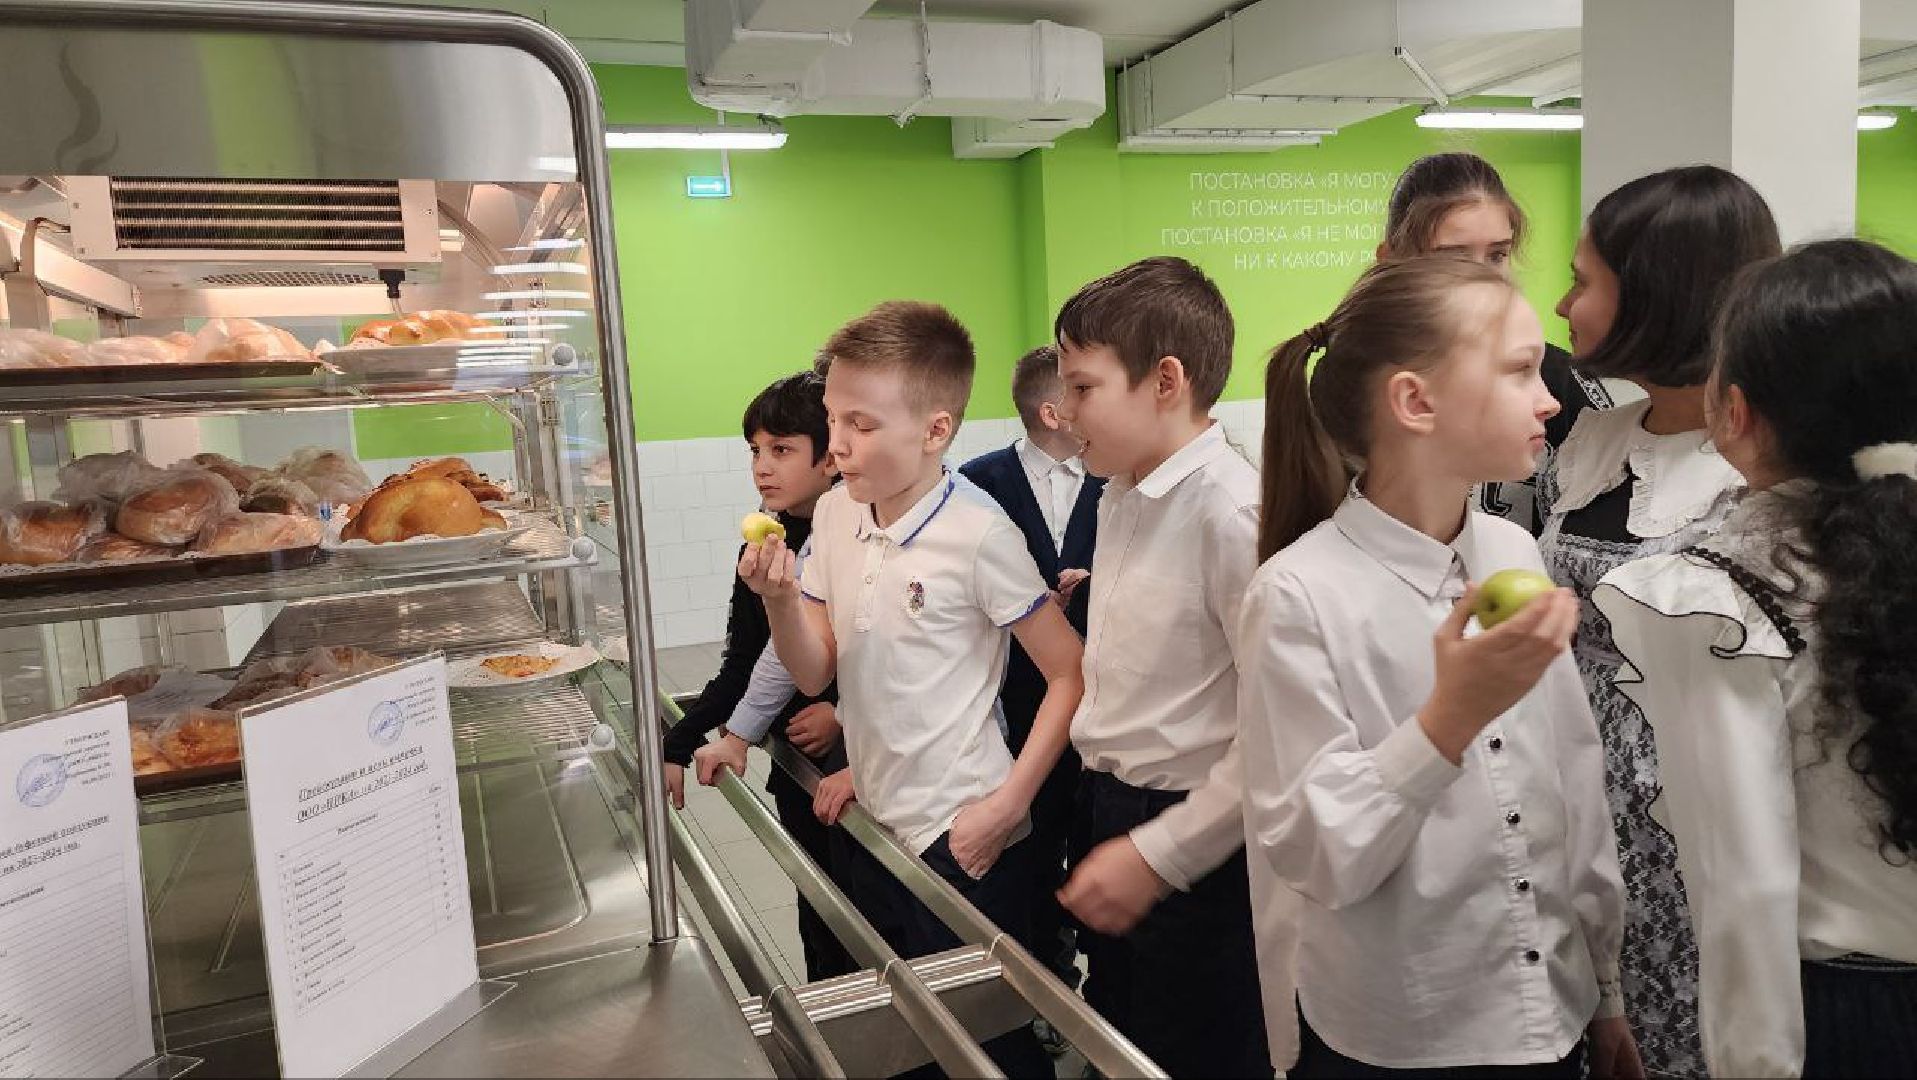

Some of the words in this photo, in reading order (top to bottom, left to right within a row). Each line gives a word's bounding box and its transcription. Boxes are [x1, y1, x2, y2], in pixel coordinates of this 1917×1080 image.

[1190, 172, 1316, 190] ПОСТАНОВКА
[1192, 199, 1202, 216] К
[1209, 199, 1388, 216] ПОЛОЖИТЕЛЬНОМУ
[1161, 227, 1287, 246] ПОСТАНОВКА
[1317, 225, 1340, 241] НЕ
[1234, 253, 1260, 270] НИ
[1267, 252, 1277, 269] К
[1282, 250, 1354, 269] КАКОМУ
